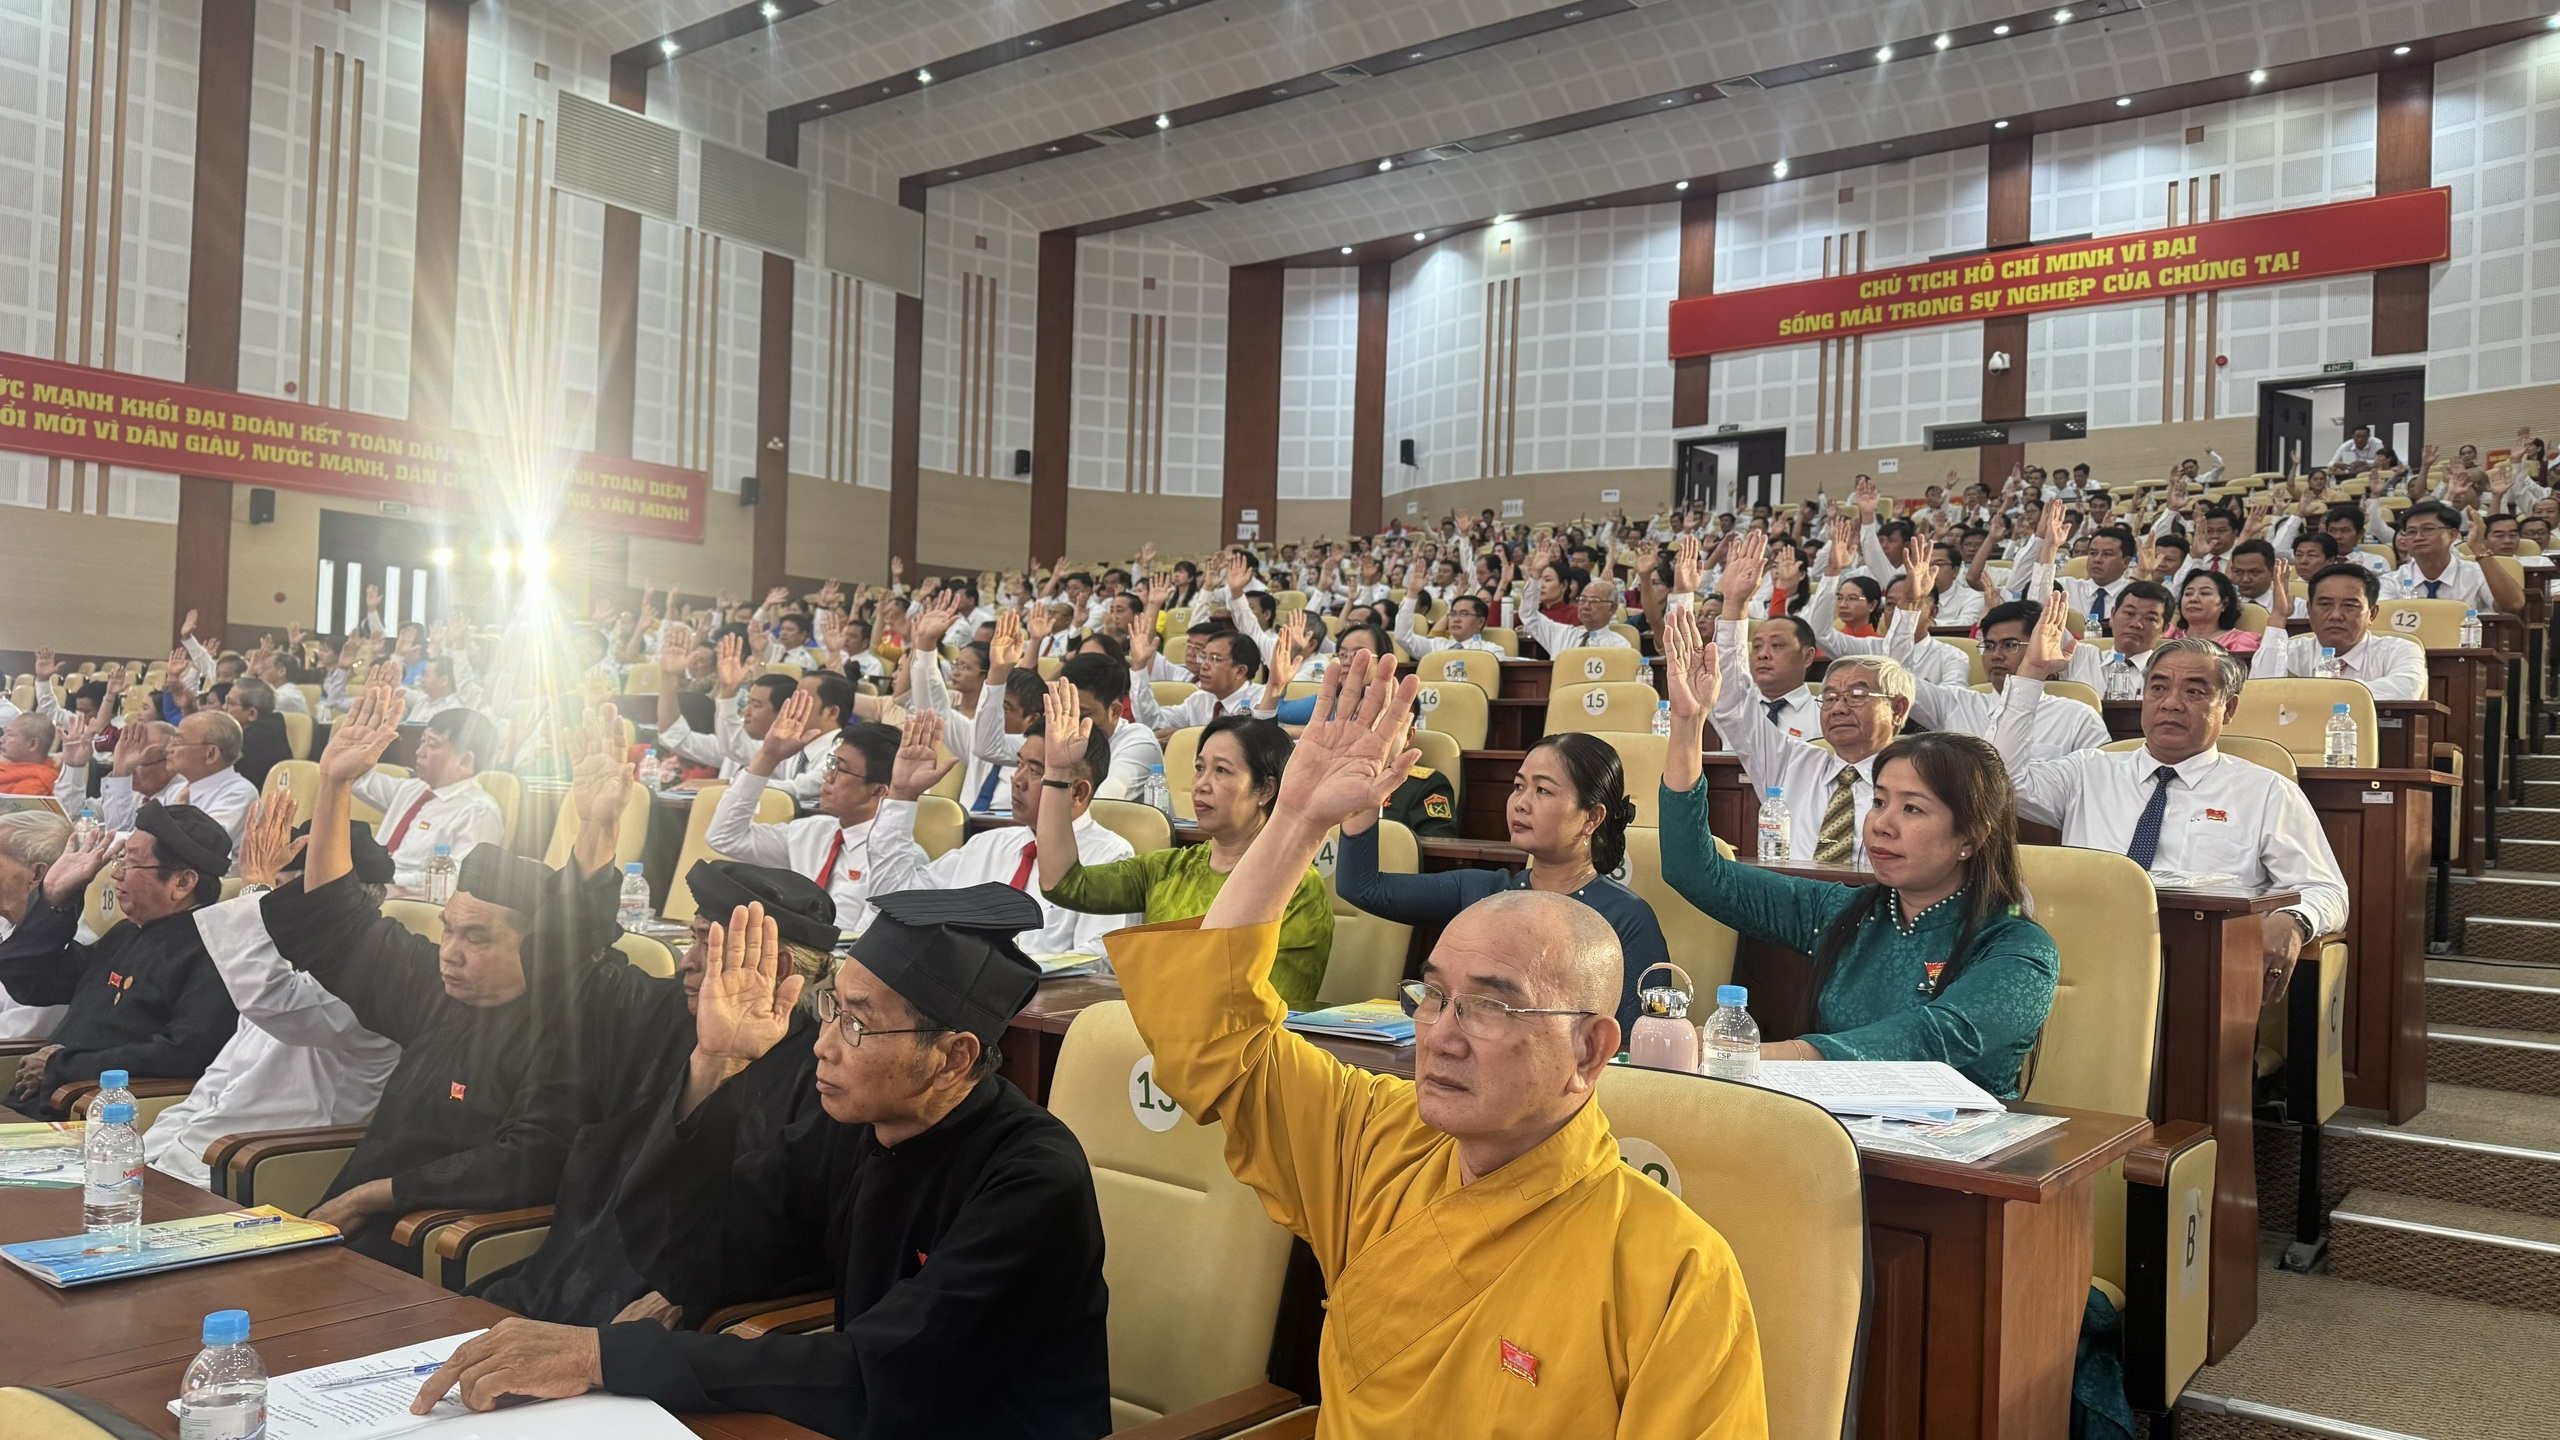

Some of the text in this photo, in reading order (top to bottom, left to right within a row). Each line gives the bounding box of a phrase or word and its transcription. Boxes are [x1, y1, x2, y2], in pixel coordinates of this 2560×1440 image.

[1859, 236, 2197, 300] CHỦ TỊCH HỒ CHÍ MINH VĨ ĐẠI
[1779, 250, 2300, 336] SỐNG MÃI TRONG SỰ NGHIỆP CỦA CHÚNG TA!
[33, 383, 114, 413] MẠNH
[120, 397, 179, 423] KHỐI
[185, 407, 226, 431] ĐẠI
[232, 414, 295, 440] ĐOÀN
[300, 422, 342, 446] KẾT
[347, 432, 404, 456] TOÀN
[33, 412, 87, 437] MỚI
[93, 419, 120, 442] VÌ
[126, 425, 178, 450] DÂN
[185, 434, 246, 462] GIÀU,
[252, 443, 314, 468] NƯỚC
[319, 452, 389, 481] MẠNH,
[638, 502, 690, 523] MINH!
[2395, 612, 2417, 628] 12
[1587, 661, 1603, 674] 16
[1421, 691, 1438, 705] 16
[1586, 693, 1605, 708] 15
[102, 889, 114, 911] 18
[1716, 1051, 1732, 1060] CSP
[2185, 1214, 2196, 1268] B
